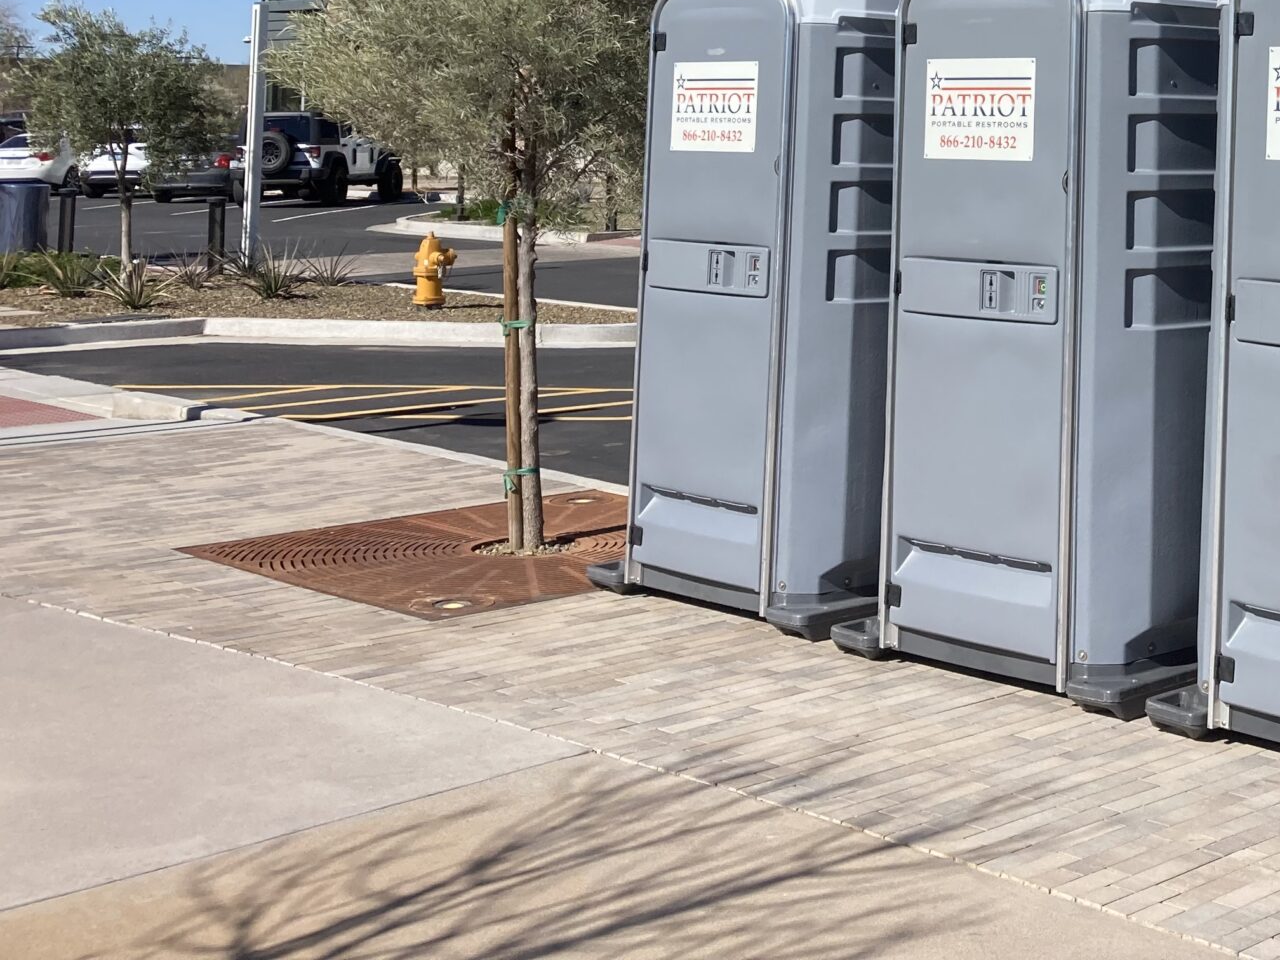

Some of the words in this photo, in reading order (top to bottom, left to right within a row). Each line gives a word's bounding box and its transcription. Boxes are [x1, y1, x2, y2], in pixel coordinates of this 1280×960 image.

[675, 92, 755, 114] PATRIOT
[930, 93, 1032, 117] PATRIOT
[931, 120, 973, 128] PORTABLE
[975, 121, 1028, 129] RESTROOMS
[682, 129, 743, 142] 866-210-8432
[939, 134, 1017, 149] 866-210-8432
